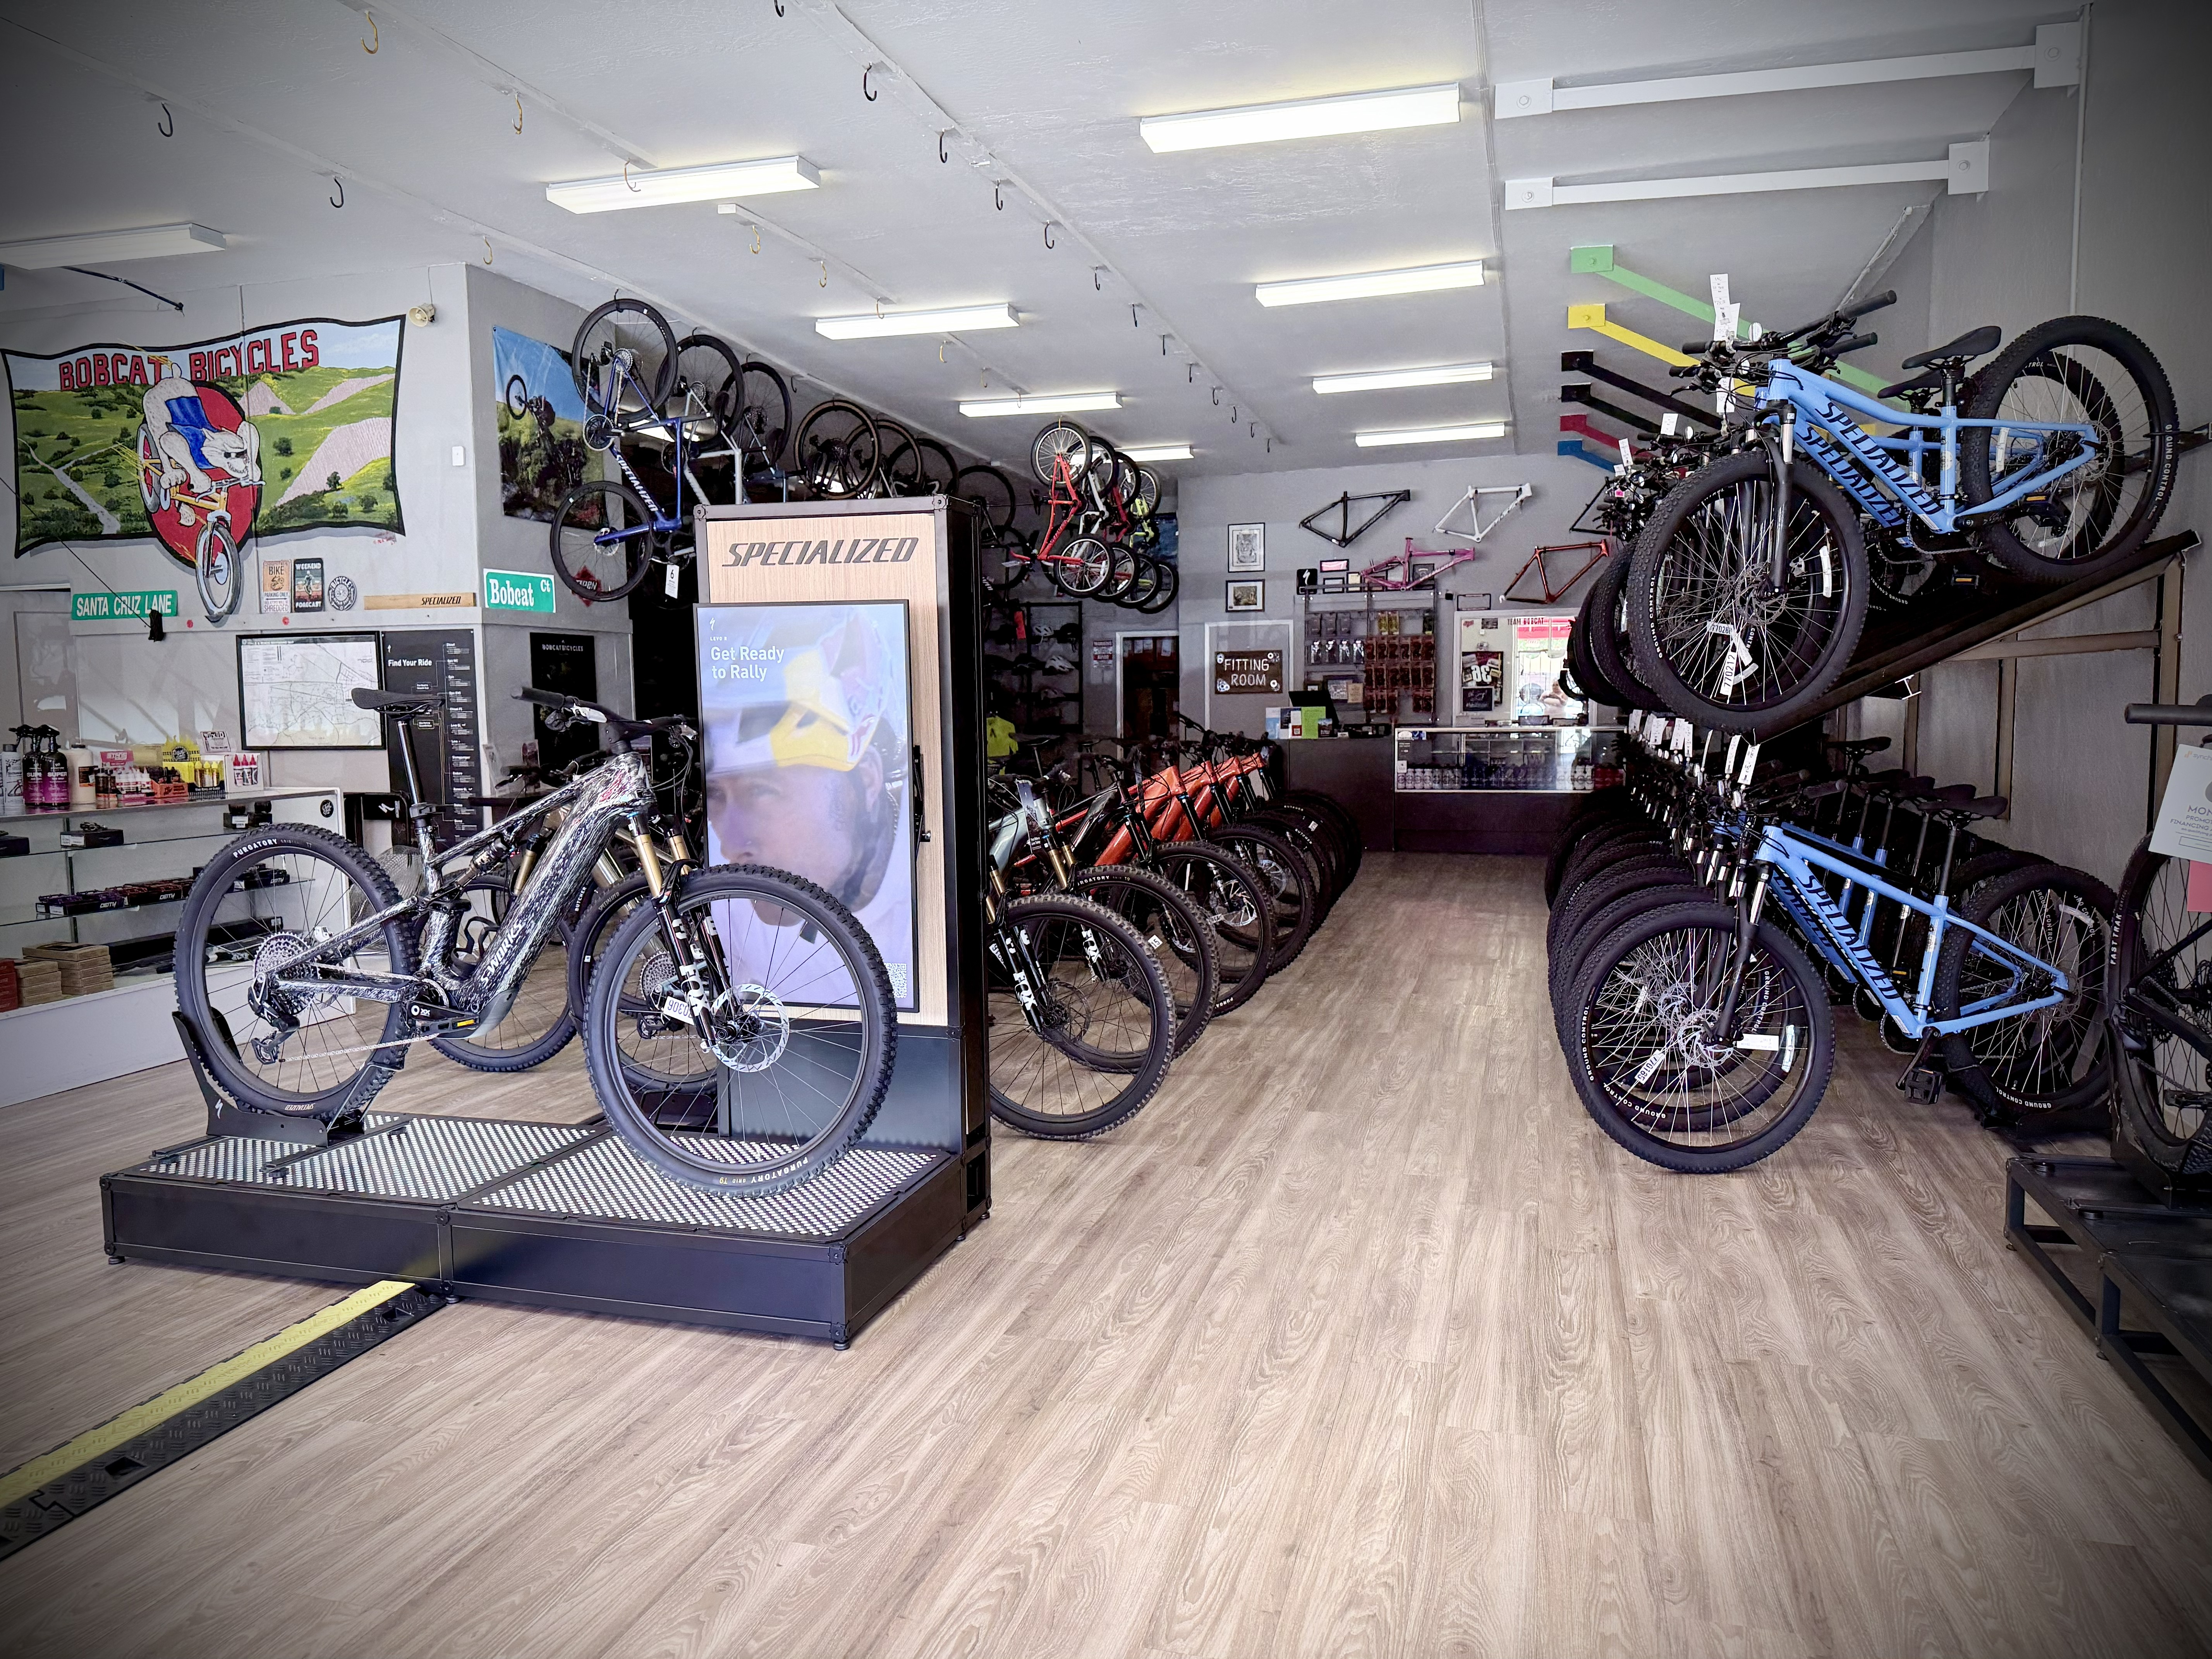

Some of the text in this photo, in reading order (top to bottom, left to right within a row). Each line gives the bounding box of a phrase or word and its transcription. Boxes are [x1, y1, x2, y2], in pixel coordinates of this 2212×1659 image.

[59, 330, 320, 391] BOBCAT BICYCLES
[1815, 402, 1942, 515] SPECIALIZED
[617, 454, 658, 512] SPECIALIZED
[2155, 463, 2171, 501] CONTROL
[722, 537, 919, 567] SPECIALIZED
[269, 566, 284, 575] BIKE
[331, 577, 352, 588] BICYCLE
[670, 569, 674, 579] 6
[421, 596, 462, 605] SPECIALIZED
[489, 578, 551, 607] Bobcat Ct
[77, 594, 172, 617] SANTA CRUZ LANE
[264, 604, 289, 612] SHREDDED
[1650, 622, 1663, 658] GROUND
[711, 646, 785, 663] Get Ready
[1224, 659, 1269, 671] FITTING
[712, 664, 768, 682] to Rally
[1231, 674, 1266, 686] ROOM
[1724, 658, 1736, 692] 770212
[2170, 819, 2209, 831] FINANCING
[233, 838, 278, 858] PURGATORY
[575, 886, 587, 912] BUTCHER
[598, 891, 620, 910] SPECIALIZED
[1797, 875, 1901, 999] SPECIALIZED
[2113, 913, 2123, 938] TRAK
[481, 918, 523, 988] S-WORKS
[1081, 929, 1103, 965] FOX
[2110, 941, 2118, 965] FAST
[679, 964, 712, 1017] FOX
[1013, 969, 1038, 1011] FOX
[1581, 1005, 1594, 1081] GROUND CONTROL
[285, 1103, 316, 1111] SPECIALIZED
[1603, 1082, 1666, 1119] GROUND CONTROL
[1996, 1086, 2023, 1104] CONTROL
[751, 1156, 809, 1184] PURGATORY
